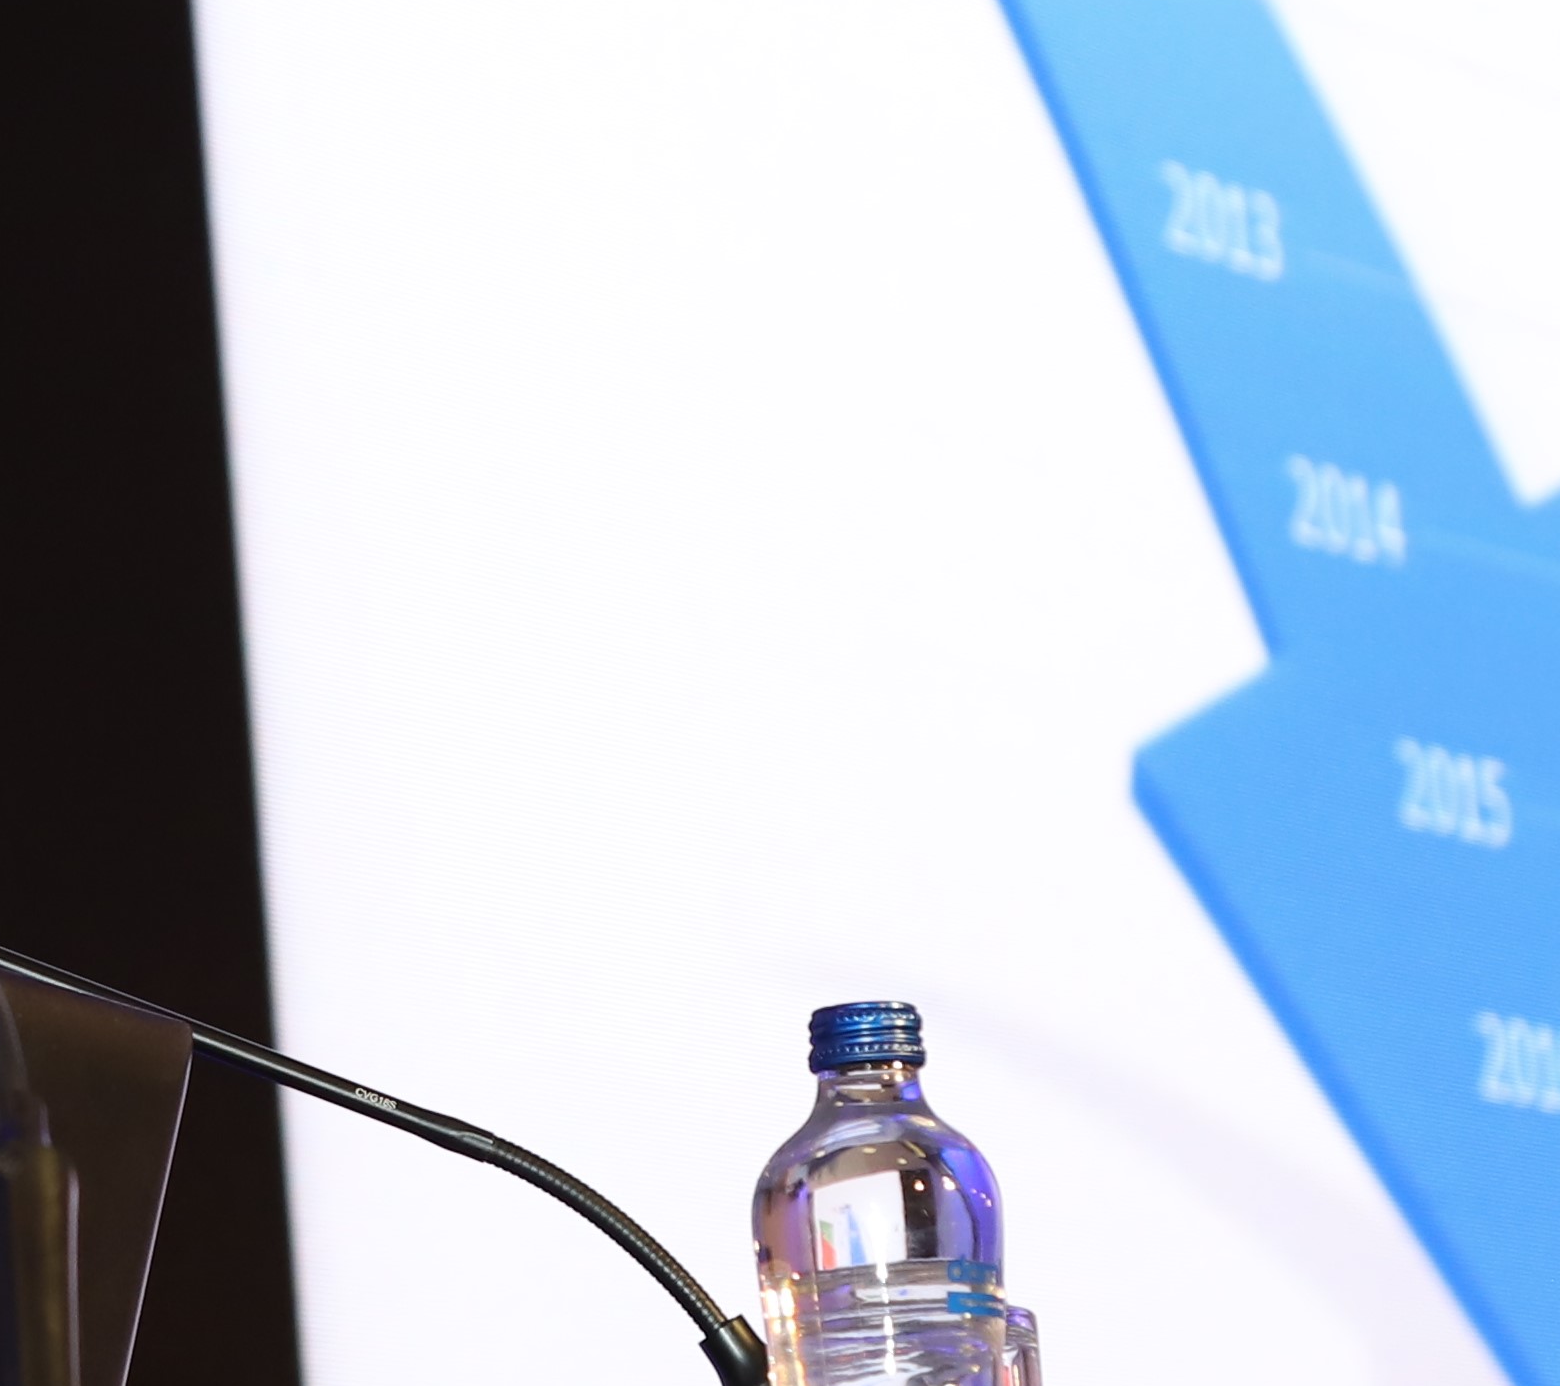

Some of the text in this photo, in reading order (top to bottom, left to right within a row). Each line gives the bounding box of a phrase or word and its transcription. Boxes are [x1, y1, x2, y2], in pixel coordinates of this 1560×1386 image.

[1163, 160, 1285, 281] 2013
[1290, 456, 1406, 563] 2014
[1395, 738, 1514, 849] 2015
